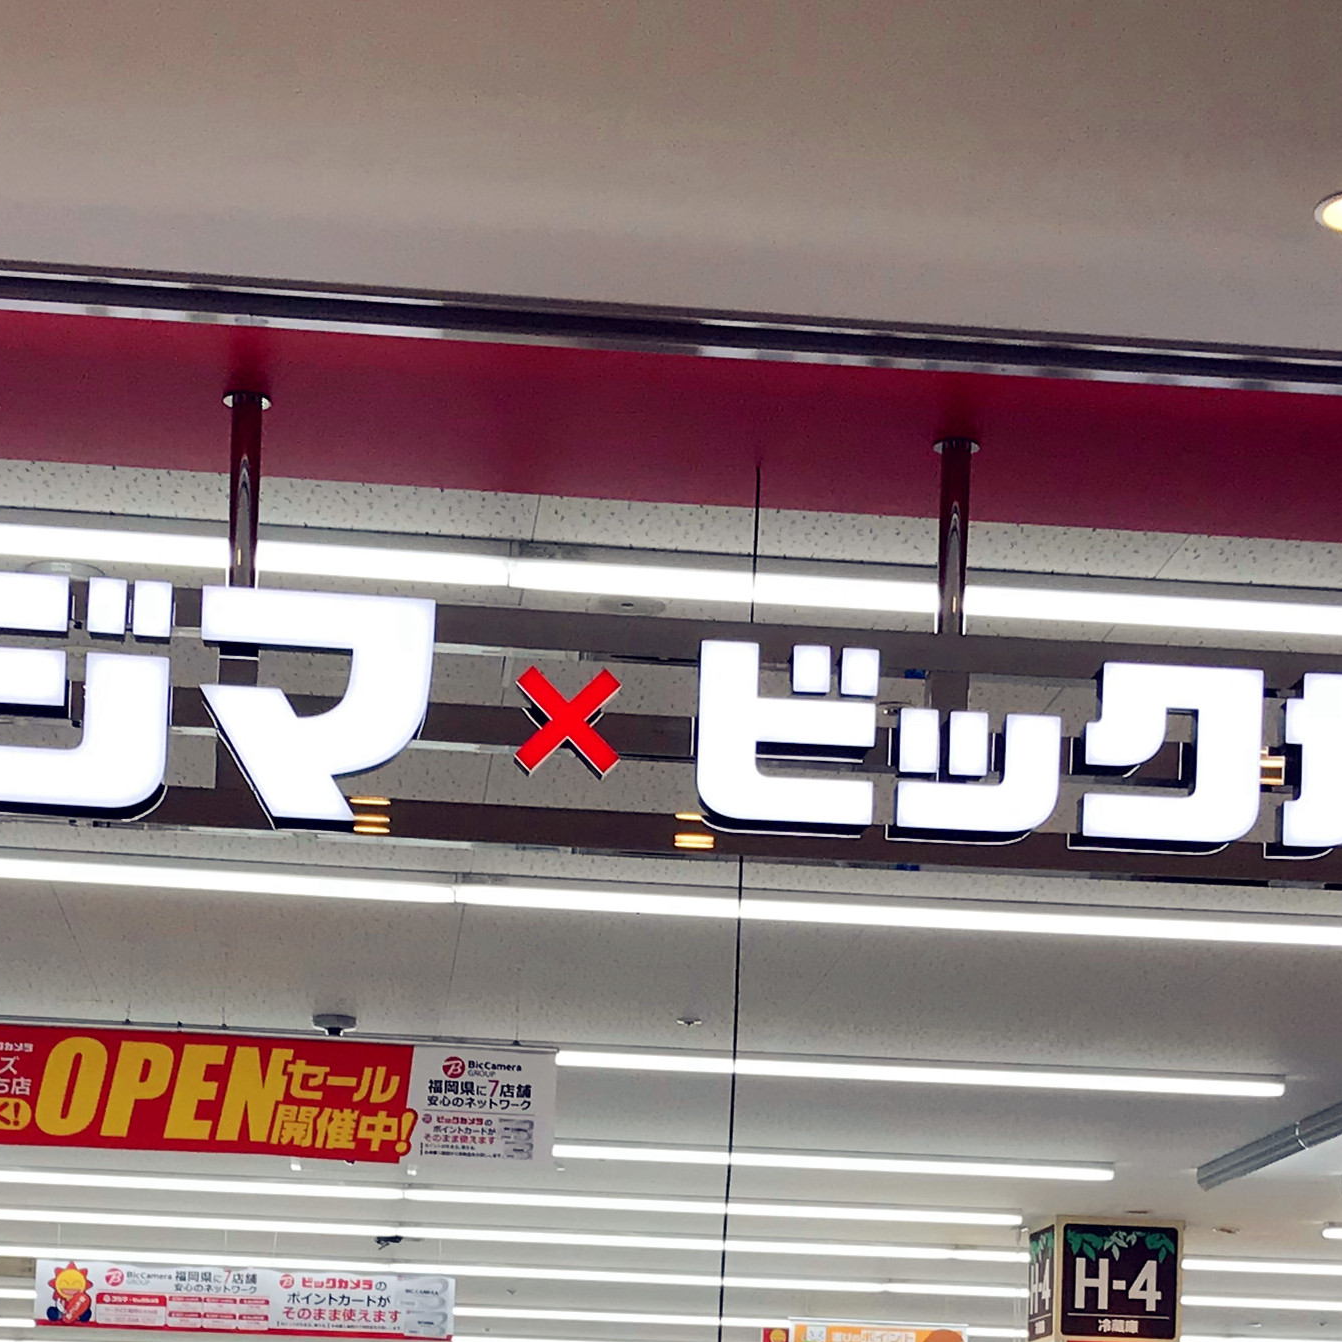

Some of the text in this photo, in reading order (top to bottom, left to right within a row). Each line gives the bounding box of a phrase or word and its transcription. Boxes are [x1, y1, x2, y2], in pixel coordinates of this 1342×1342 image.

[468, 1061, 522, 1071] BicCamera
[36, 1037, 294, 1142] OPEN
[287, 1060, 400, 1103] セール
[428, 1080, 532, 1098] 福岡県に7店舗
[427, 1096, 531, 1110] 安心のネットワーク
[275, 1107, 418, 1153] 開催中!
[127, 1271, 172, 1281] BicCamera
[175, 1269, 257, 1285] 福岡県に7店舗
[1074, 1257, 1162, 1311] H-4
[174, 1284, 257, 1294] 安心のネットワーク
[1030, 1258, 1051, 1315] H-4
[283, 1307, 401, 1322] そのまま使えます
[1098, 1319, 1139, 1334] 冷蔵庫
